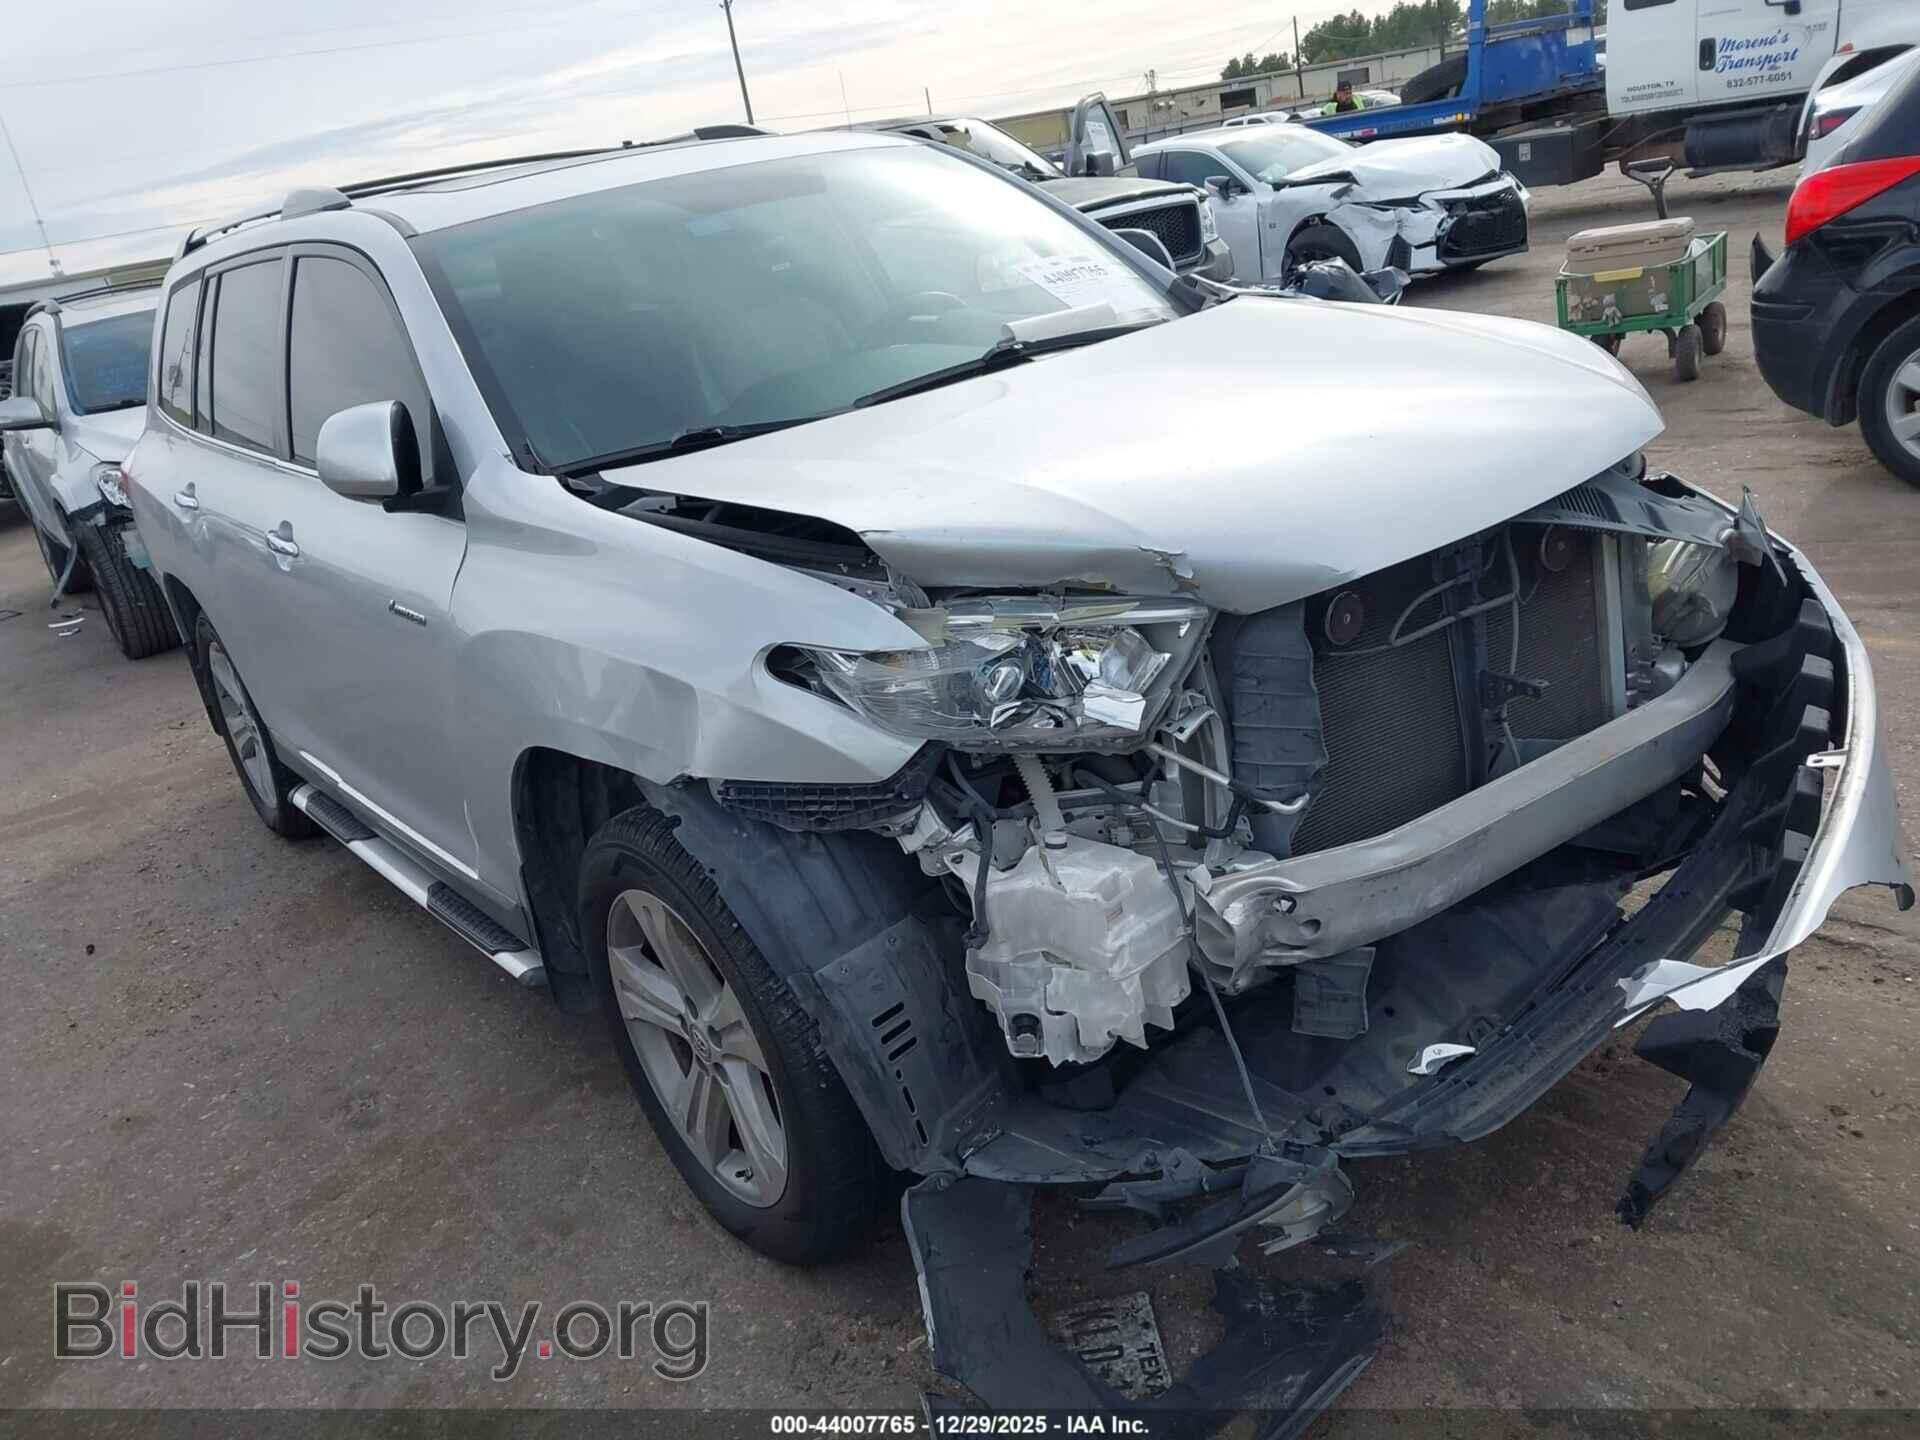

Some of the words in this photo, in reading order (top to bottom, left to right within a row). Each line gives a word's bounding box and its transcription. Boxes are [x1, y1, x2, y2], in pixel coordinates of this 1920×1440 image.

[1718, 28, 1790, 54] Moreno's
[1714, 47, 1799, 74] Transport
[1726, 71, 1793, 89] 832-577-6051
